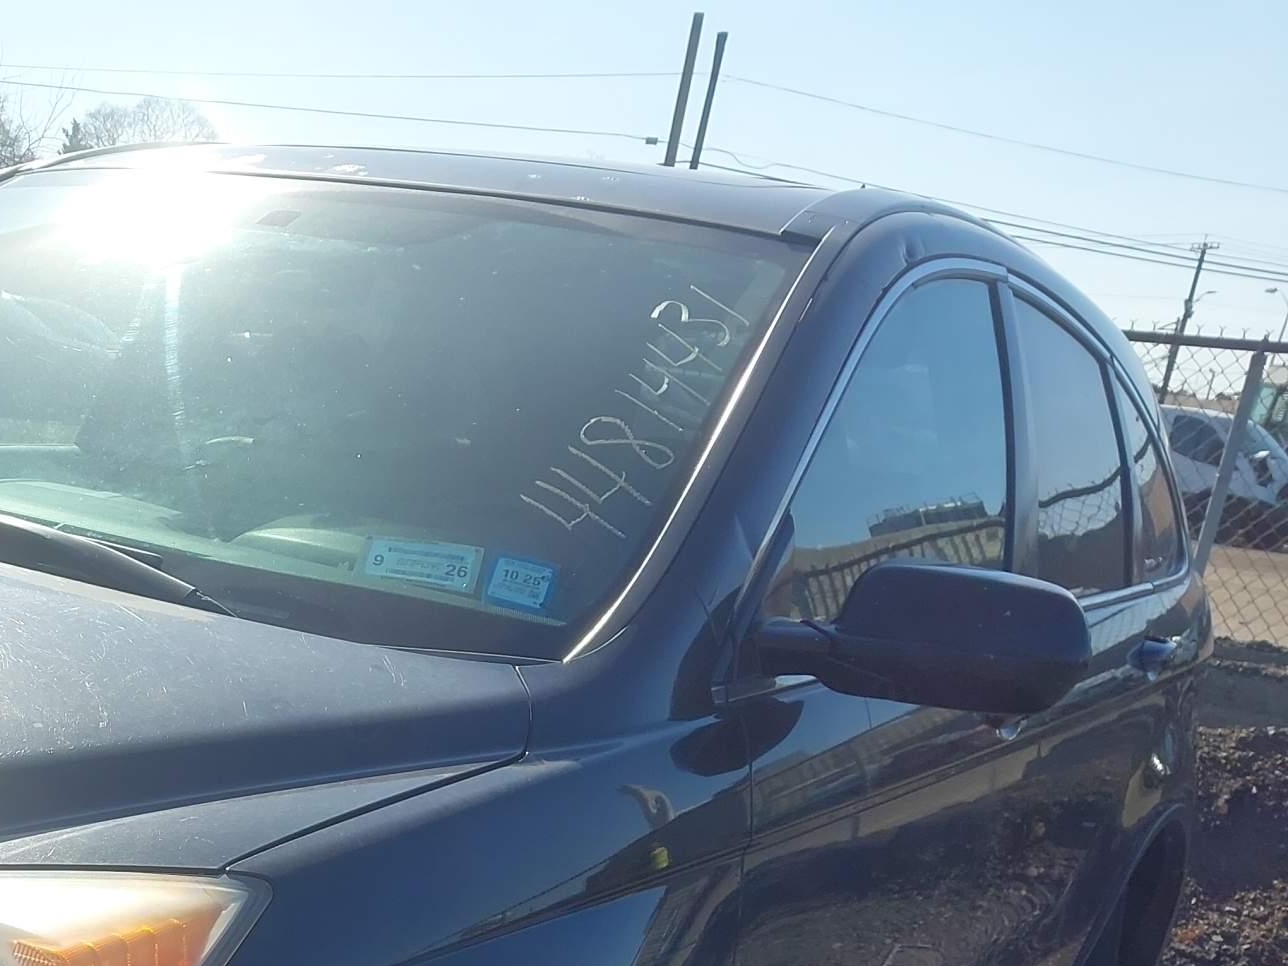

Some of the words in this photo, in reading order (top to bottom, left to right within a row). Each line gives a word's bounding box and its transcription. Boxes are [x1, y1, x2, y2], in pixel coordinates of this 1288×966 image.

[372, 554, 385, 567] 9
[444, 564, 468, 578] 26
[502, 568, 519, 581] 10
